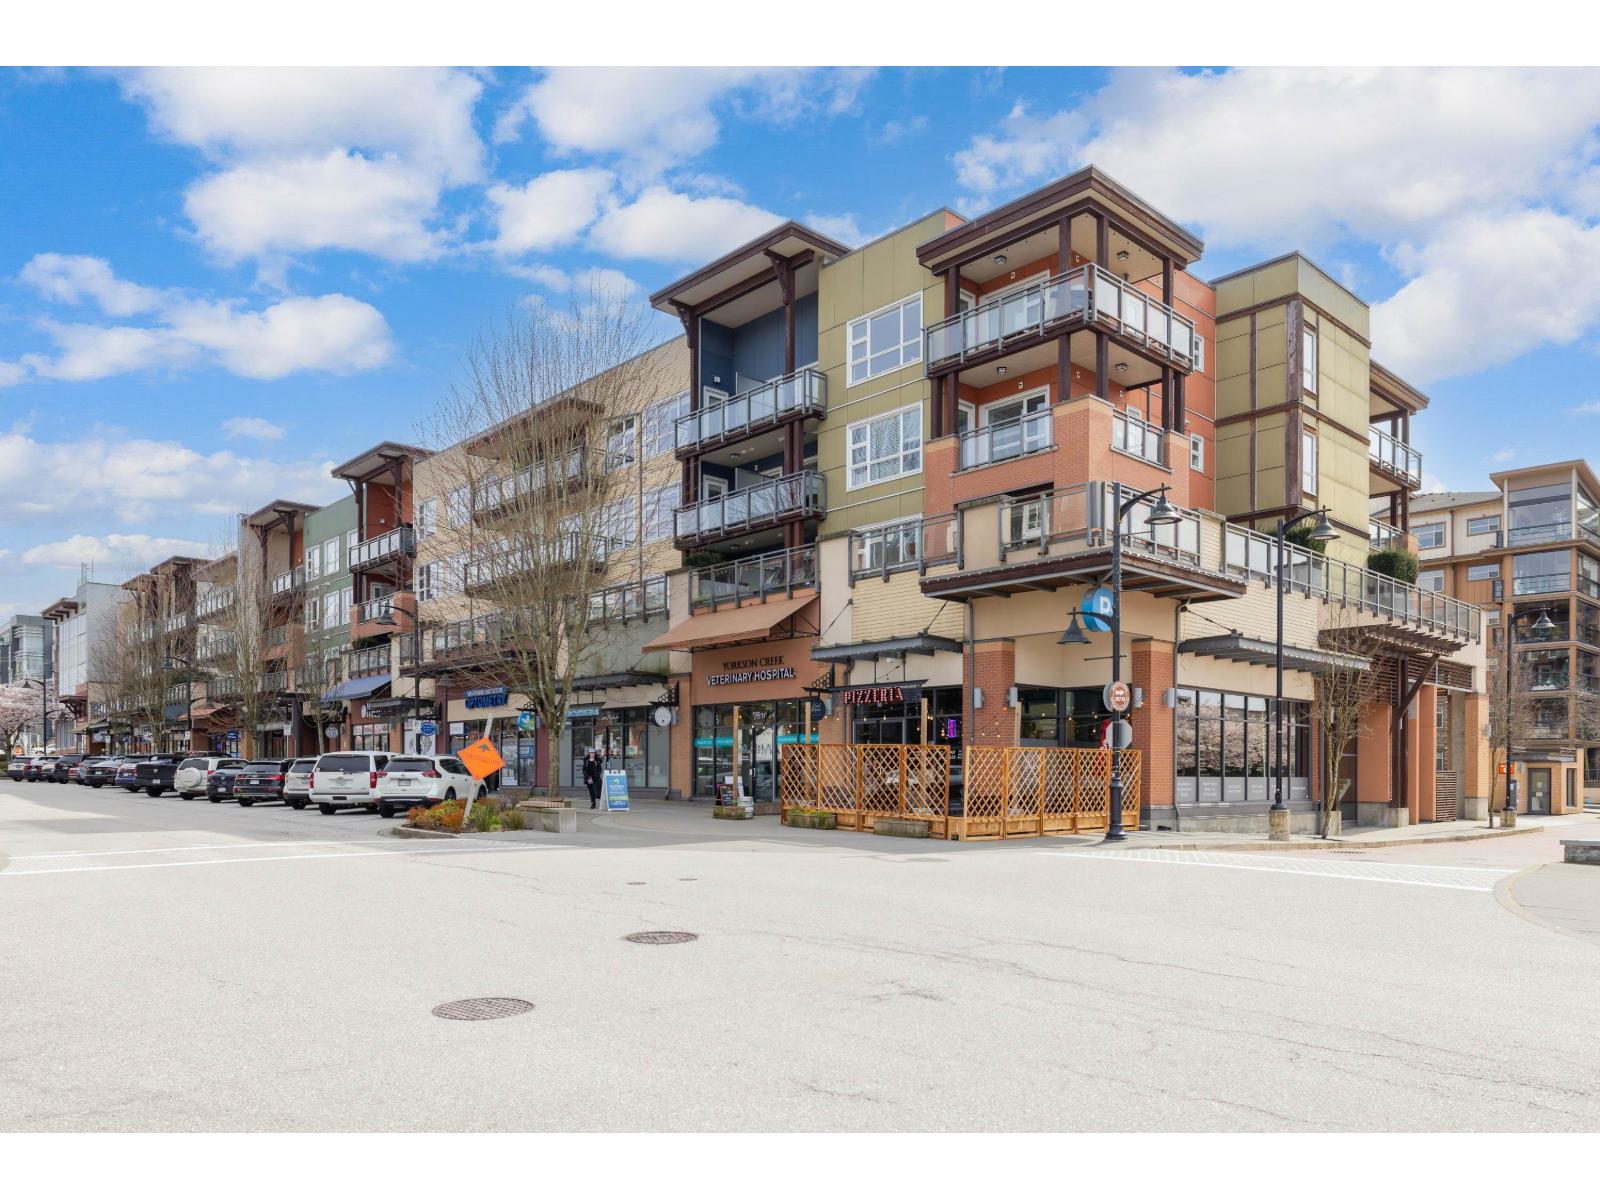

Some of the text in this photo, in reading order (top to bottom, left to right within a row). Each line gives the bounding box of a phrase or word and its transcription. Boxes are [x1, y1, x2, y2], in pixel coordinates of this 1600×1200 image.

[722, 655, 784, 671] YORKSON CREEK
[706, 667, 795, 686] VETERINARY HOSPITAL
[844, 687, 904, 704] PIZZERIA
